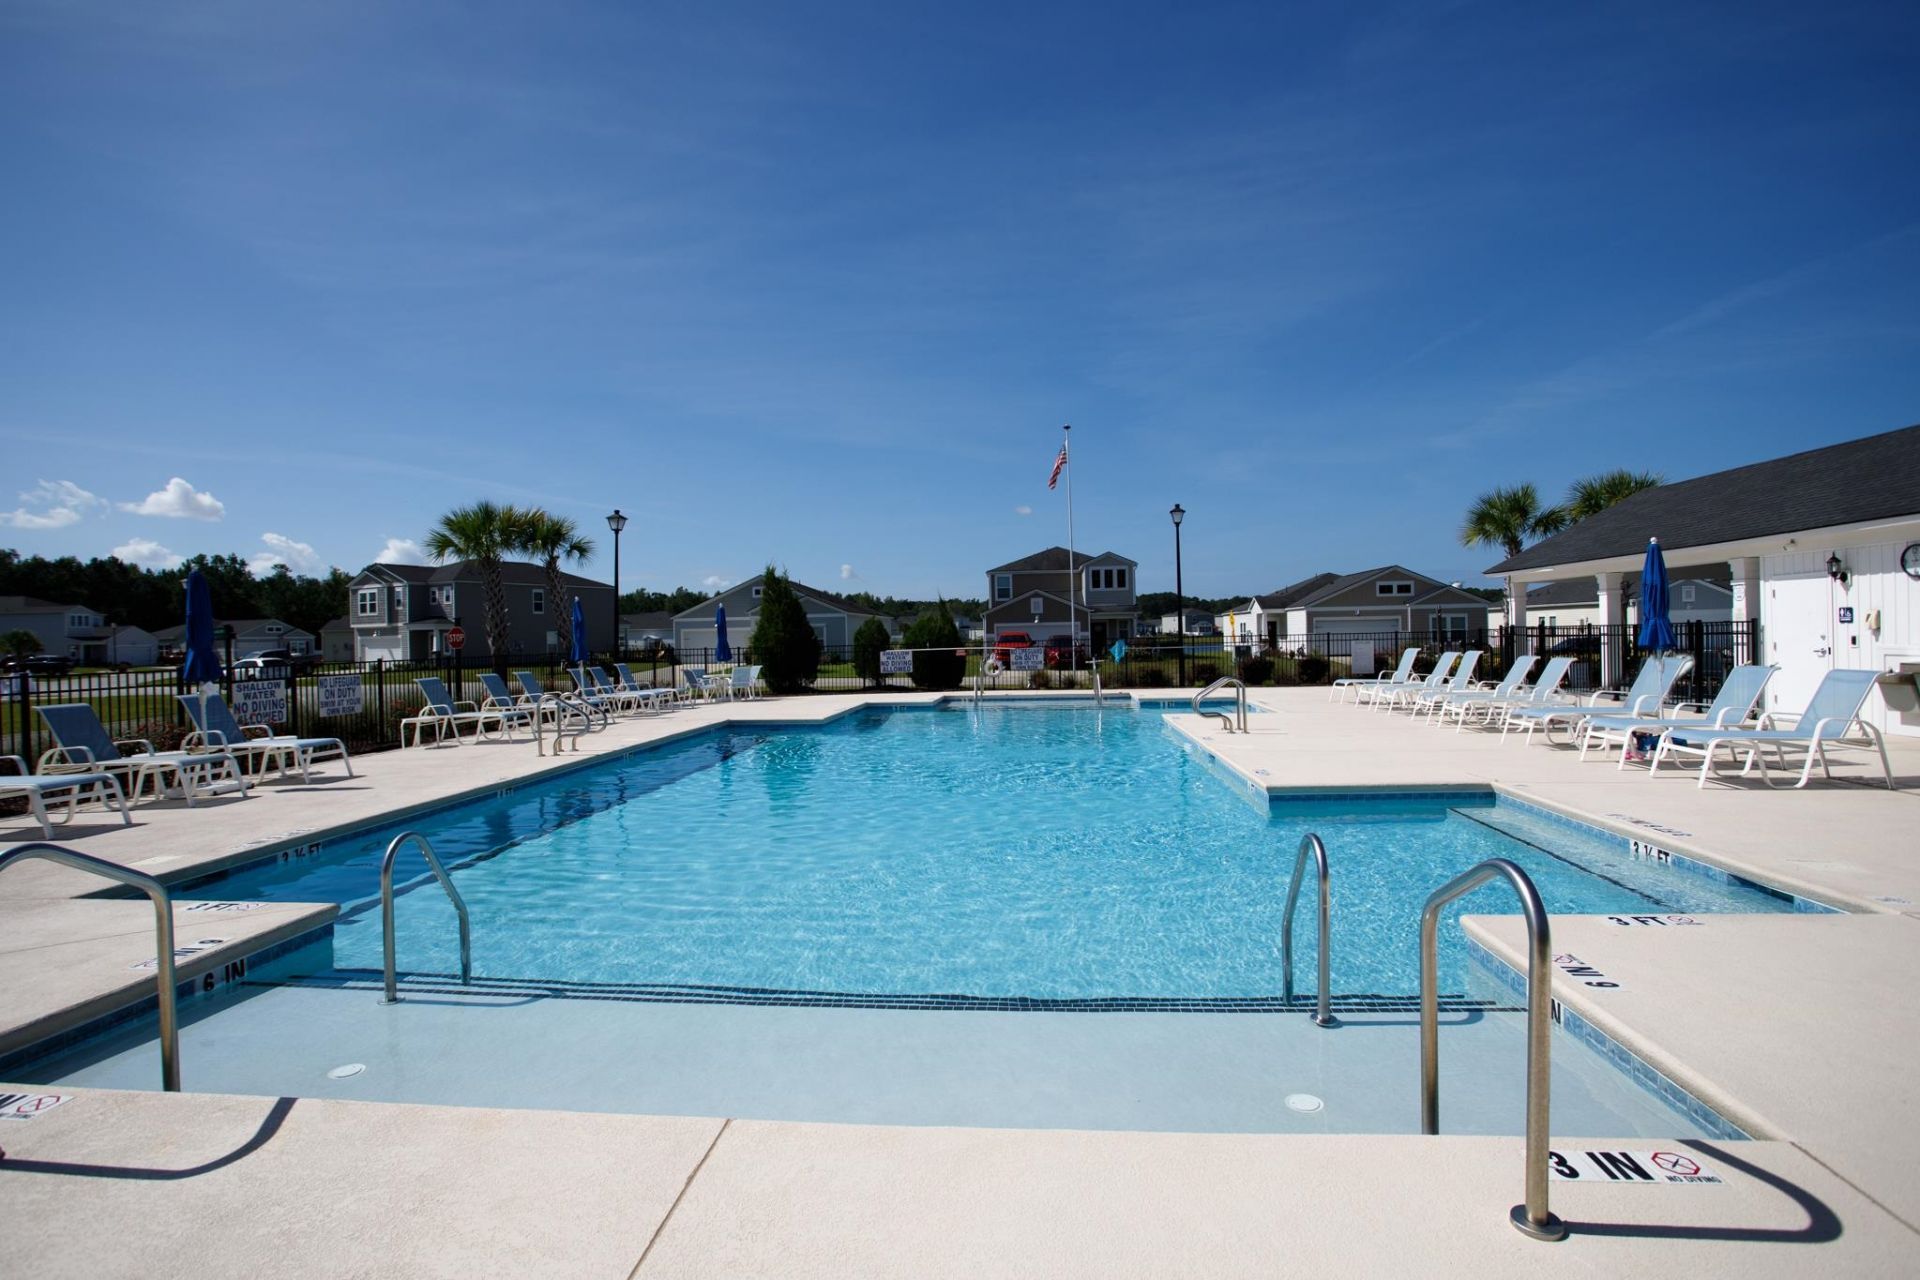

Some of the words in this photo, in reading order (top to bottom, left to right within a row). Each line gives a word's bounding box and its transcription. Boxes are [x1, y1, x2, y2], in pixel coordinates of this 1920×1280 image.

[449, 633, 464, 643] STOP
[236, 681, 281, 693] SHALLOW
[324, 689, 335, 700] ON
[337, 687, 356, 699] DUTY
[243, 690, 276, 701] WATER
[233, 702, 249, 714] NO
[251, 698, 285, 712] DIVING
[237, 710, 284, 726] ALLOWED
[1656, 848, 1670, 864] FT
[1608, 916, 1631, 926] 3
[1631, 916, 1667, 926] FT
[202, 972, 215, 992] 6
[224, 958, 246, 984] IN
[1547, 1151, 1580, 1179] 3
[1585, 1151, 1655, 1181] IN
[1665, 1175, 1684, 1183] NO
[1684, 1175, 1722, 1184] DIVING
